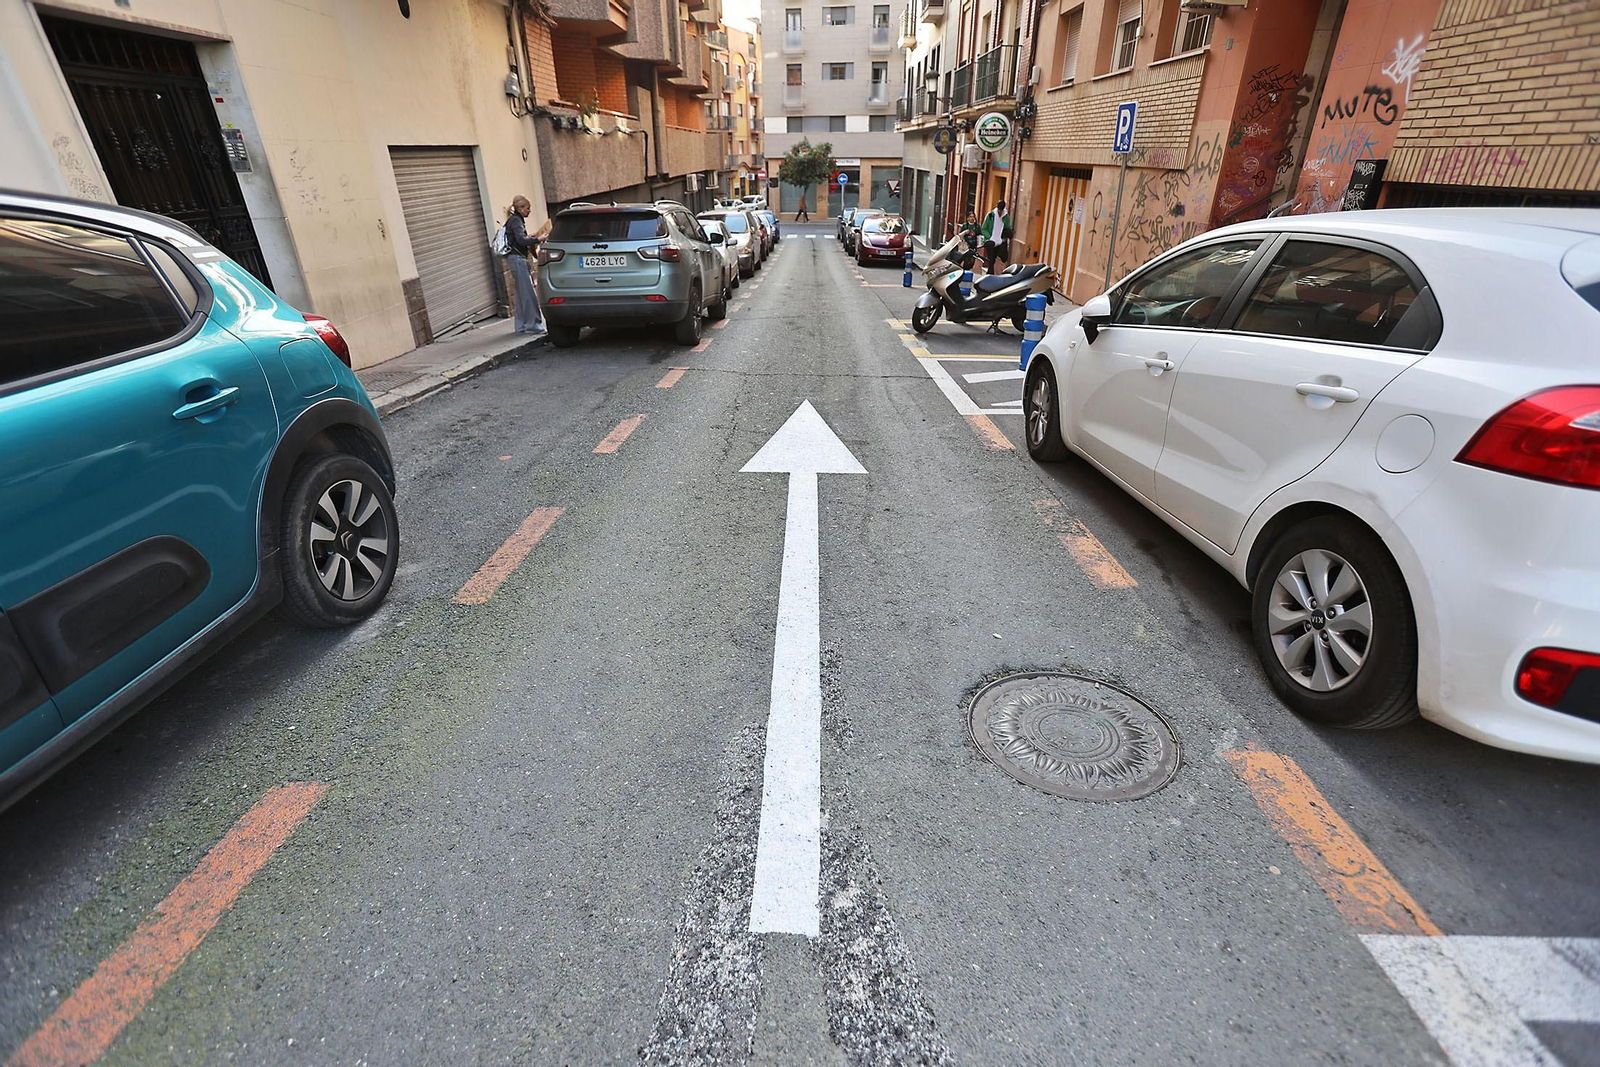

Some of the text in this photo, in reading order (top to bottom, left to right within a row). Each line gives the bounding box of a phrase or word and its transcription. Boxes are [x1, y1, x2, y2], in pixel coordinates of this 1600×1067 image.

[1116, 108, 1131, 147] P
[585, 256, 625, 267] 4628 LYC
